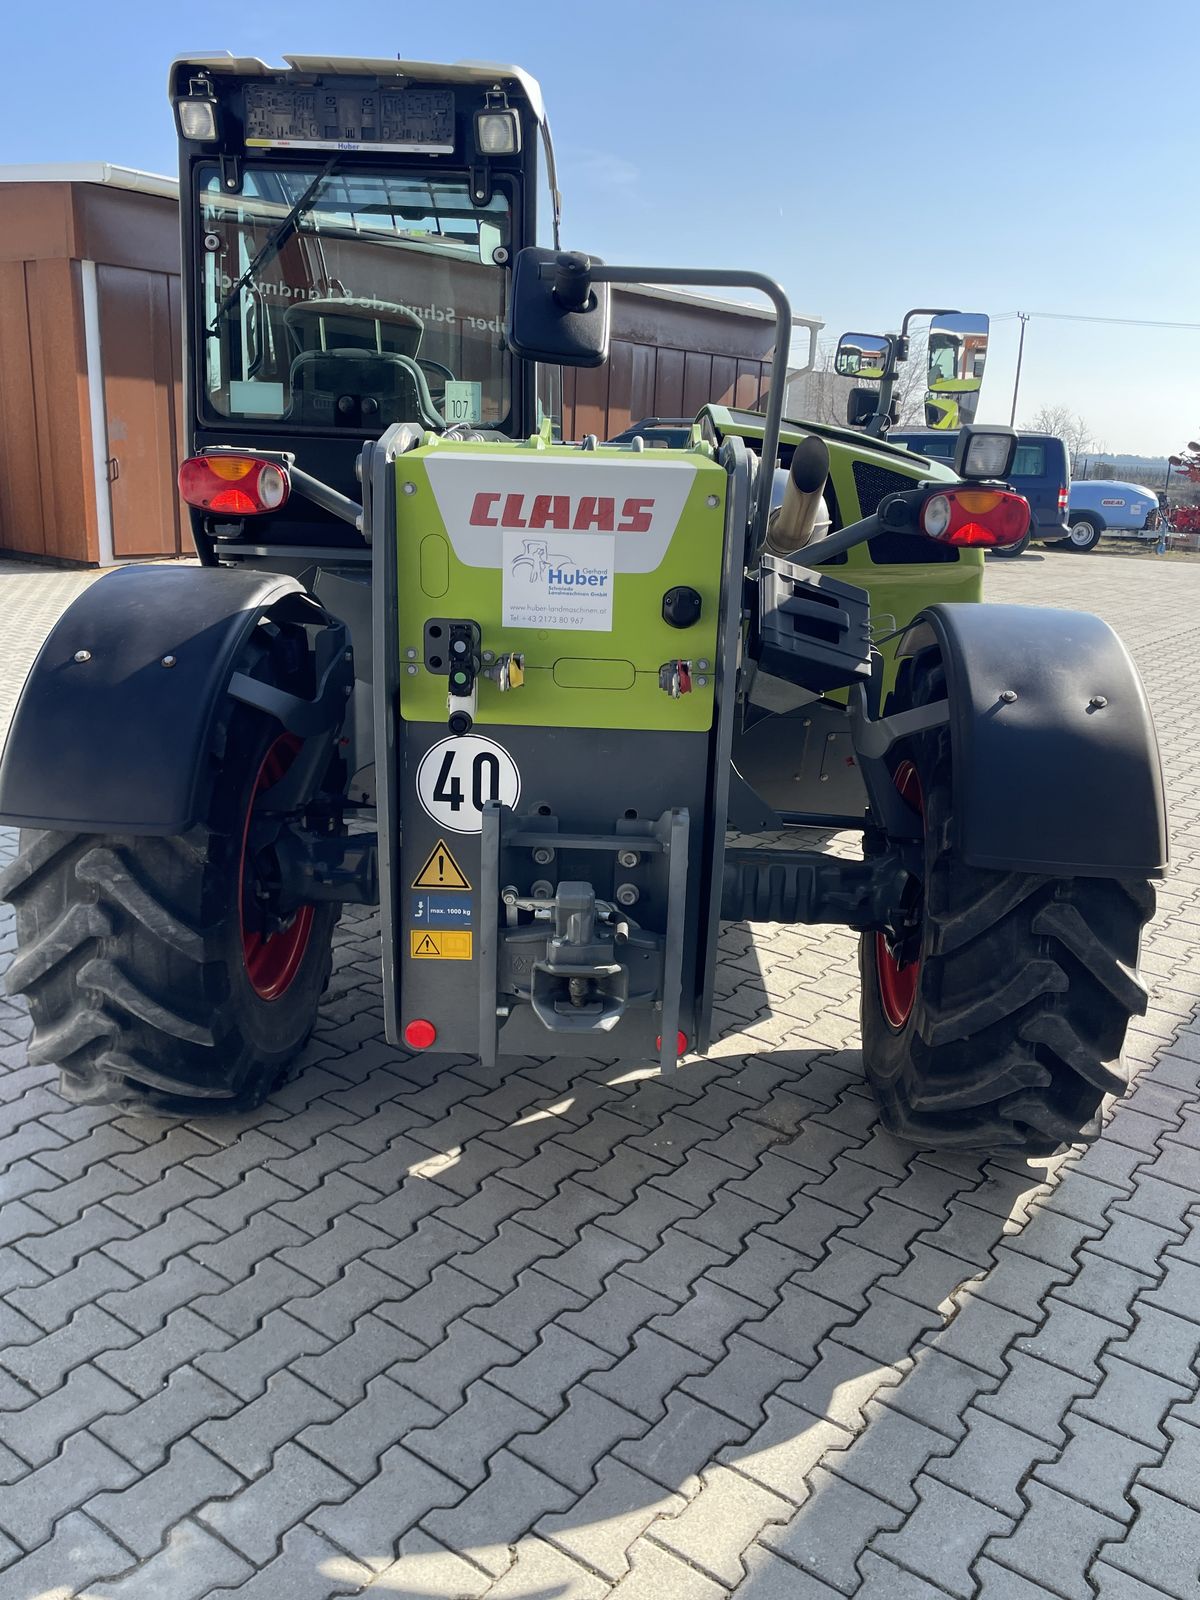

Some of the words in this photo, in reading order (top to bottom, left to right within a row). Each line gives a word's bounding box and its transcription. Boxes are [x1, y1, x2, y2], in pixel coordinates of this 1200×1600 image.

[338, 142, 360, 150] Huber
[451, 399, 469, 419] 107
[469, 492, 655, 533] CLAAS
[582, 567, 608, 575] Gerhard
[548, 569, 608, 586] Huber
[509, 604, 608, 615] www.huber-landmaschinen.at
[539, 616, 557, 624] 2173
[559, 616, 569, 624] 80
[571, 617, 584, 625] 967
[433, 751, 499, 811] 40
[462, 909, 471, 917] kg
